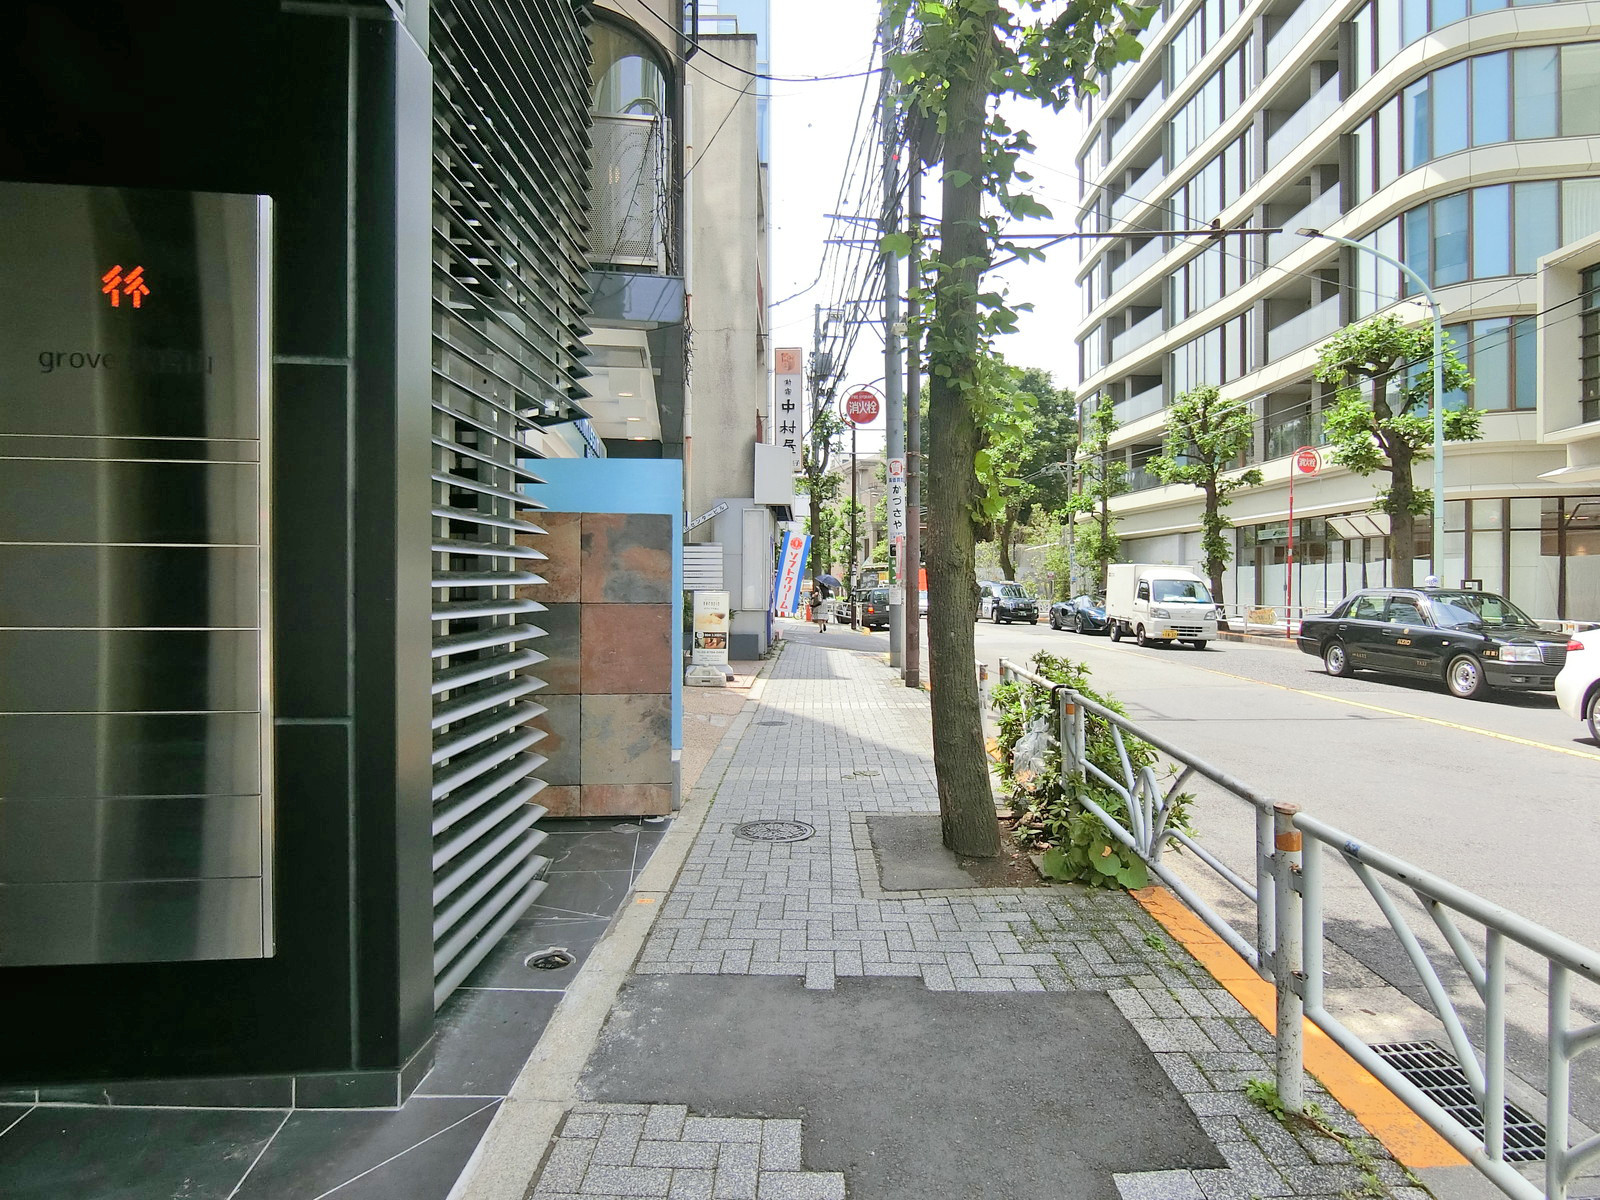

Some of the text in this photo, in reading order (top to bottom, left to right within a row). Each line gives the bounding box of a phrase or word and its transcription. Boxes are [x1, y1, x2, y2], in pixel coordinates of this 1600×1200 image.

[849, 401, 877, 414] 消火栓
[780, 551, 799, 609] ソフトクリーム
